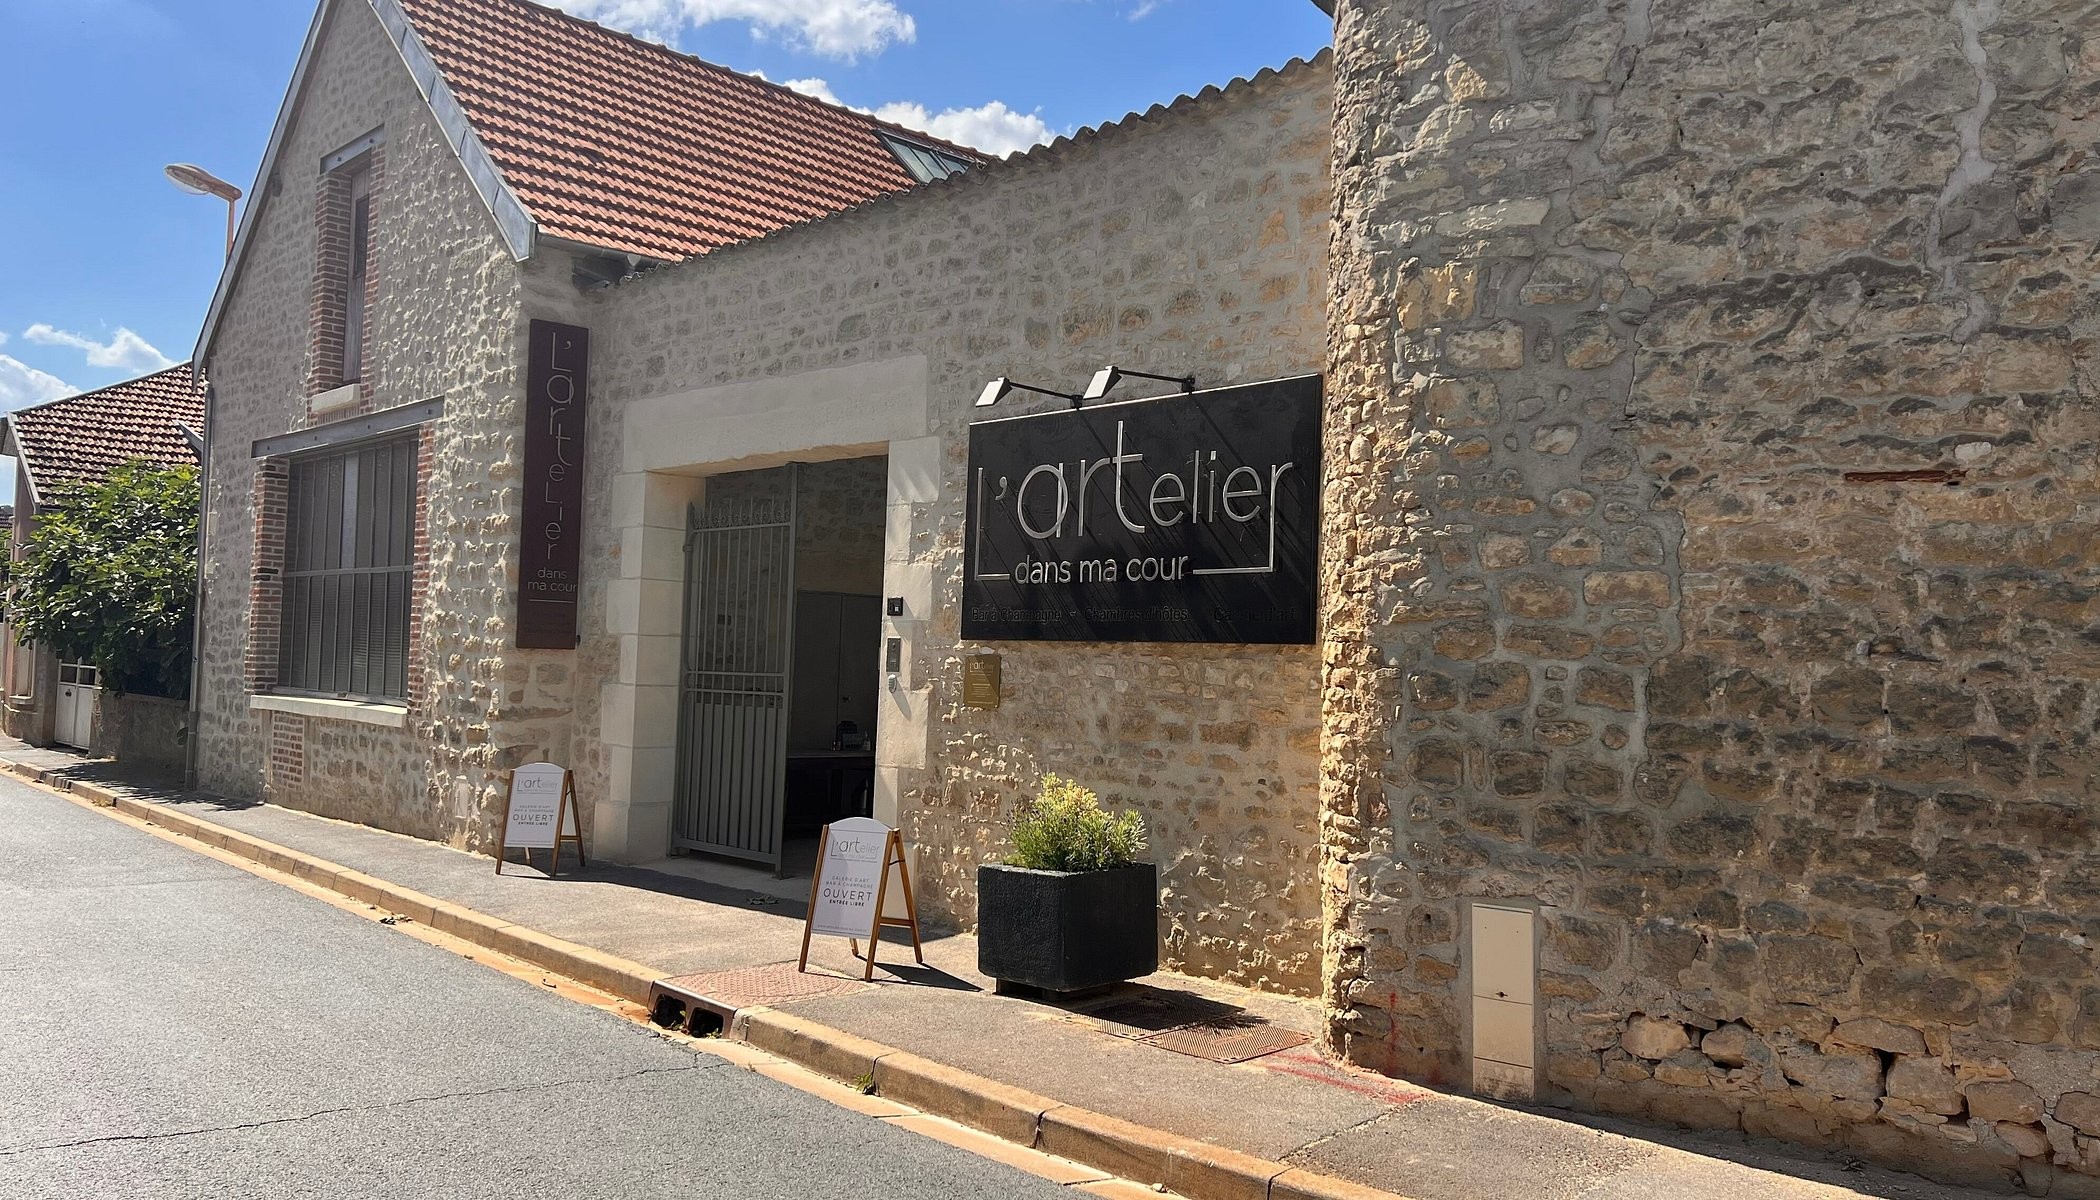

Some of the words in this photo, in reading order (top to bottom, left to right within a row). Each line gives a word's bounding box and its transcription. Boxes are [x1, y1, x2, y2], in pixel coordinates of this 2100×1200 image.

[537, 567, 568, 579] dans
[1014, 554, 1072, 584] dans
[1078, 558, 1118, 584] ma
[1125, 555, 1189, 583] cour
[527, 581, 547, 591] ma
[550, 582, 578, 592] cour
[971, 607, 989, 622] Bar
[512, 813, 554, 822] OUVERT
[823, 888, 873, 902] OUVERT
